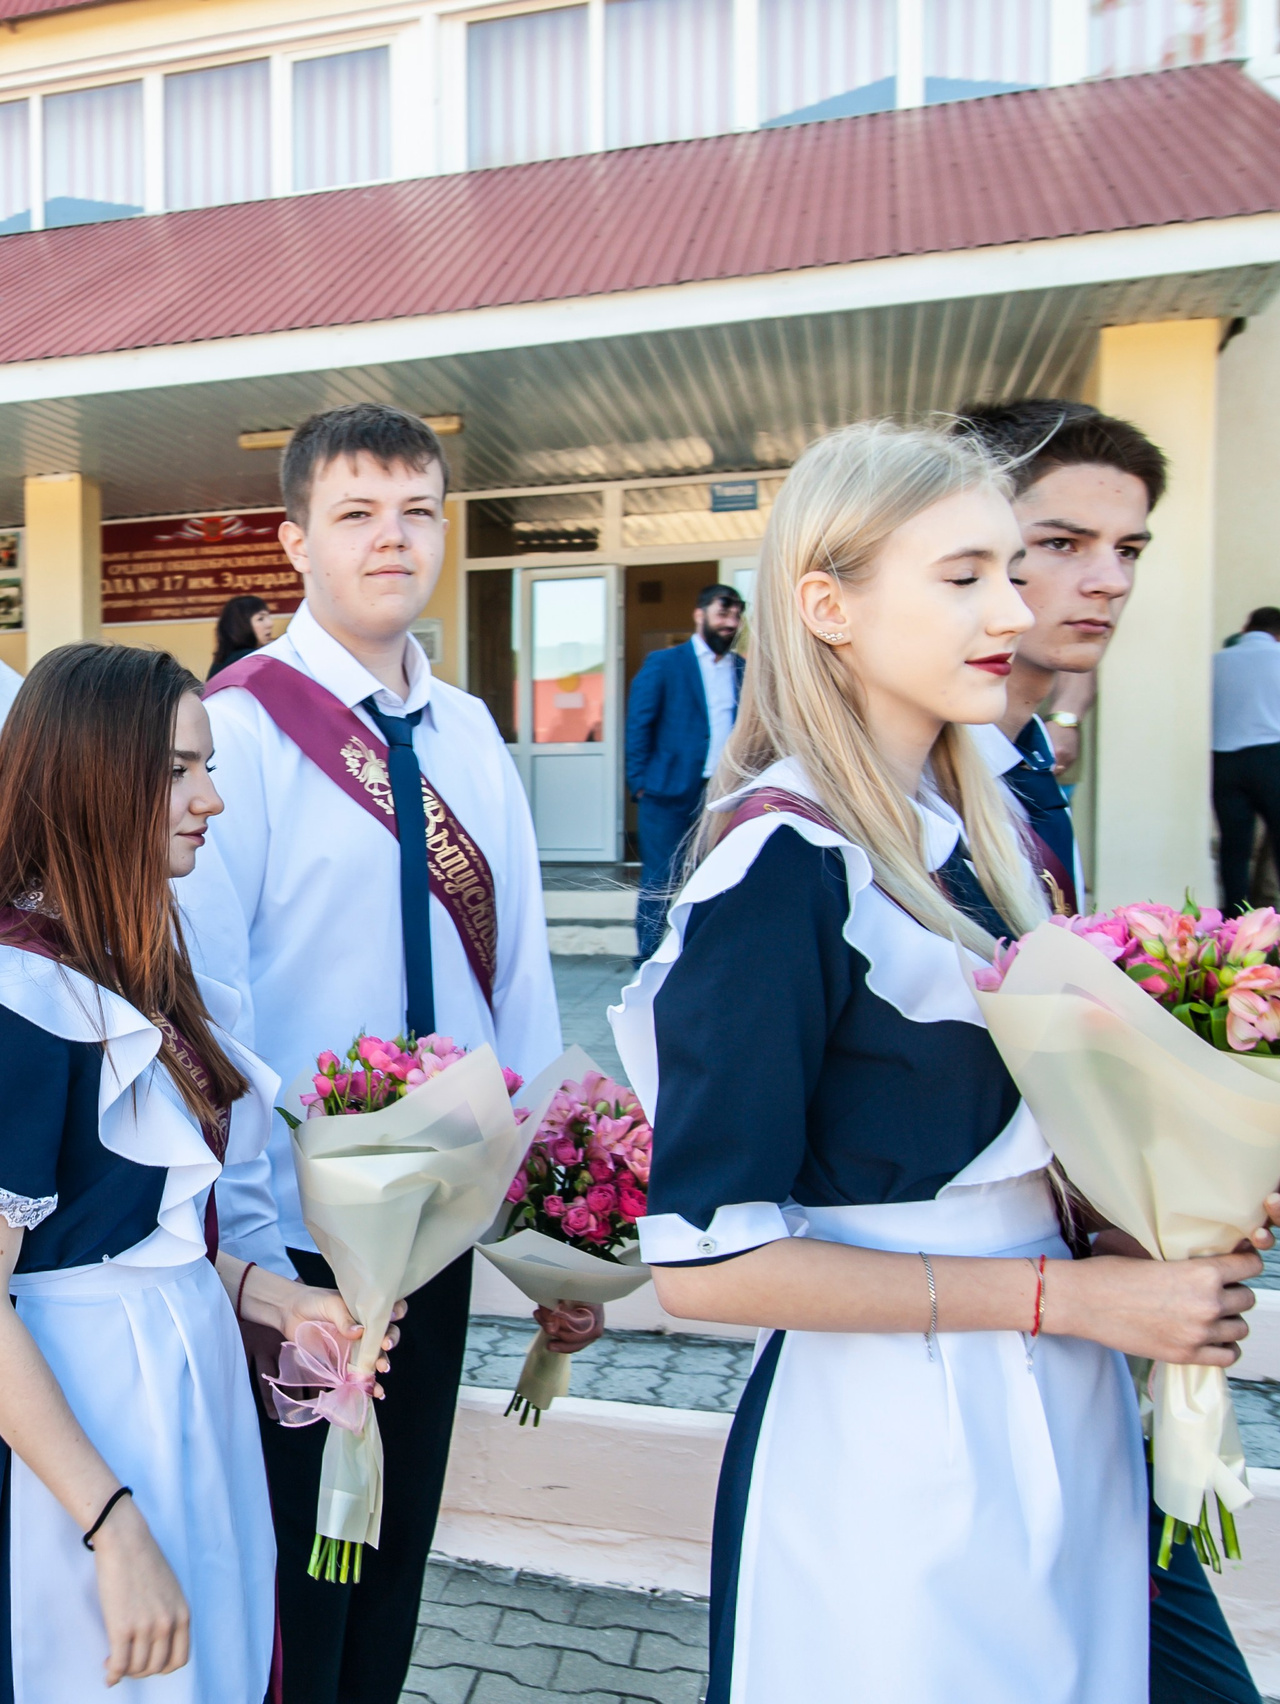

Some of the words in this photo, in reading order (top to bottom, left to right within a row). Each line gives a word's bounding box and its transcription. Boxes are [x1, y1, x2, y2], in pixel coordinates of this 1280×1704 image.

[101, 578, 135, 595] ОЛА
[162, 575, 185, 591] 17
[220, 571, 297, 590] Эдуарда
